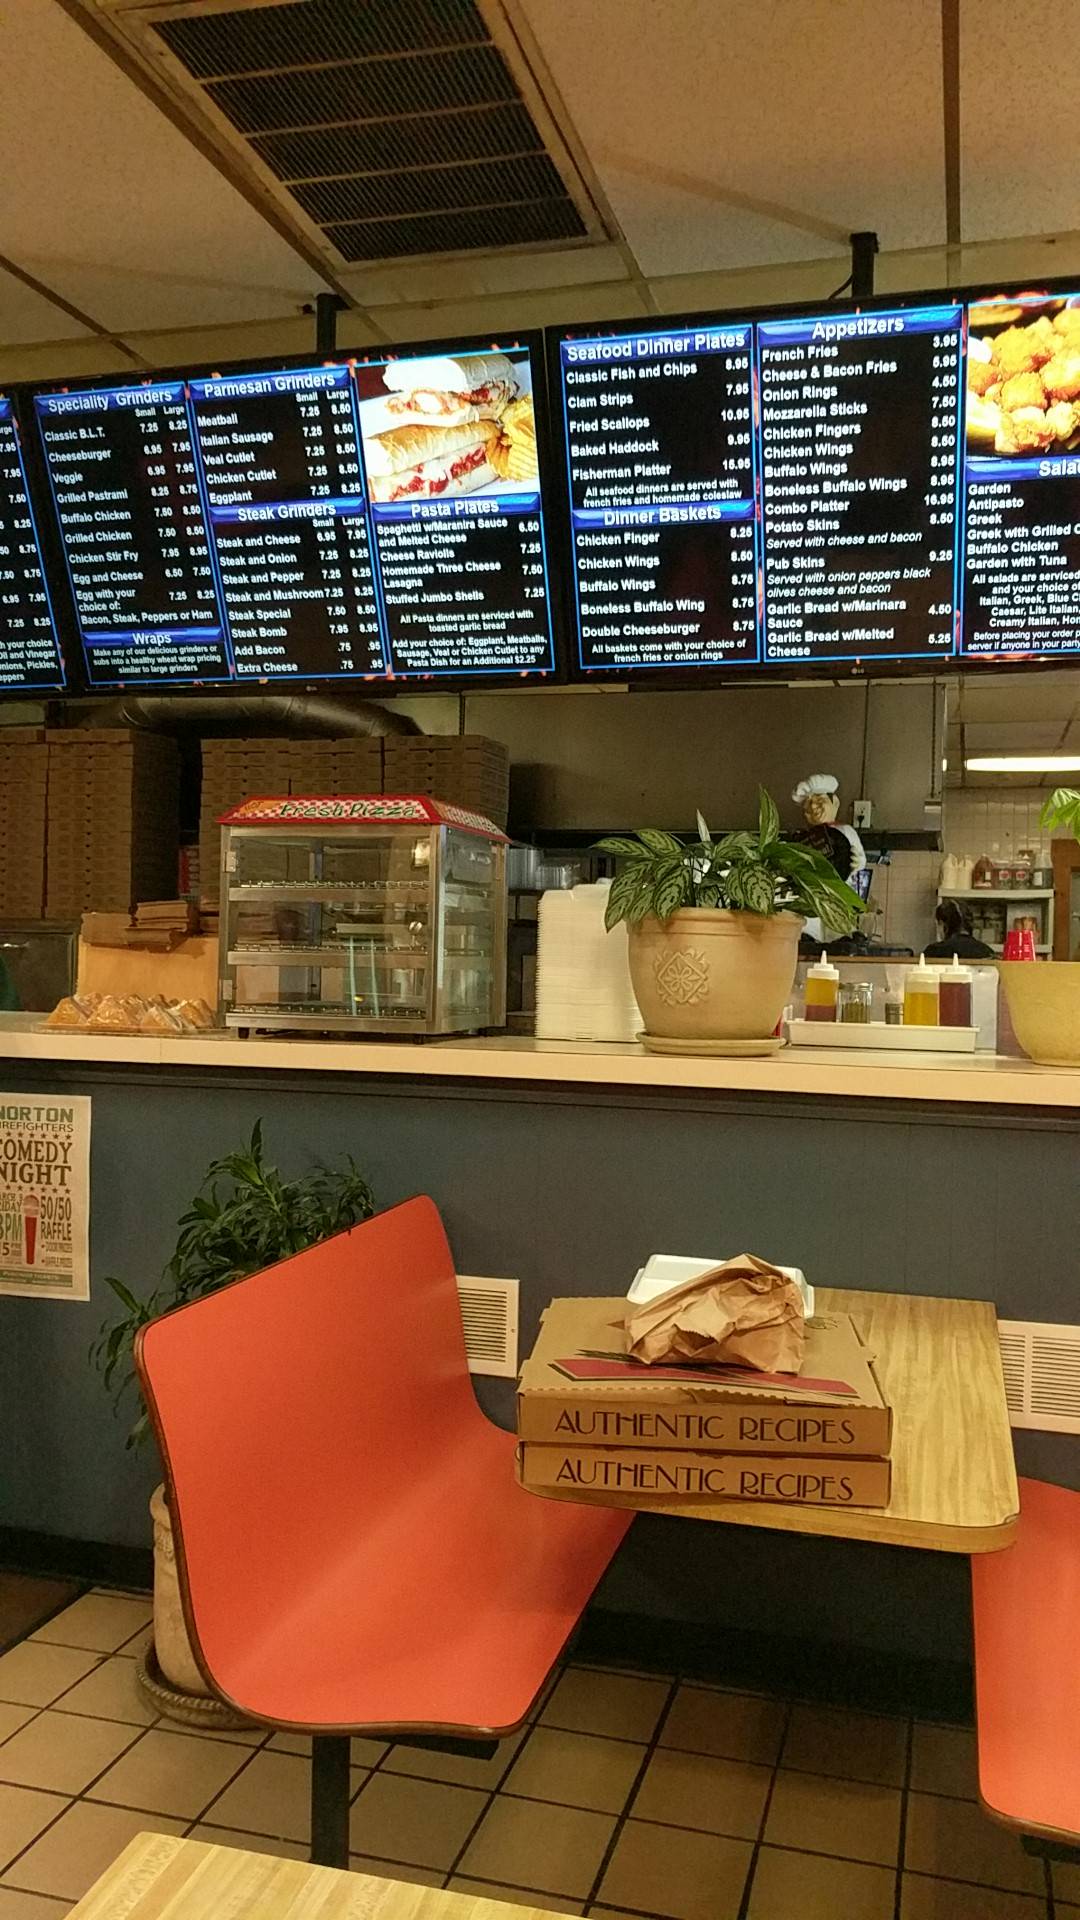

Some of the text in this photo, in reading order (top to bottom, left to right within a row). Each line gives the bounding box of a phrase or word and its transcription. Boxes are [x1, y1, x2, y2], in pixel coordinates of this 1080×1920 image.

[812, 317, 904, 340] Appetizers
[568, 333, 745, 361] Seafood Dinner Plates
[763, 346, 839, 362] French Fries
[567, 362, 697, 384] Classic Fish and Chips
[763, 361, 897, 382] Cheese & Bacon Fries
[205, 374, 335, 397] Parmesan Grinders
[296, 391, 349, 402] Small Large
[568, 393, 633, 408] Clam Strips
[763, 386, 837, 401] Onion Rings
[49, 390, 172, 414] Speciality Grinders
[135, 406, 184, 417] Small Large
[763, 403, 867, 421] Mozzarella Sticks
[198, 413, 237, 427] Meatball
[570, 417, 650, 433] Fried Scallops
[45, 430, 77, 441] Classic
[764, 423, 861, 440] Chicken Fingers
[201, 432, 273, 446] Italian Sausage
[49, 449, 111, 462] Cheeseburger
[571, 440, 659, 457] Baked Haddock
[204, 452, 255, 466] Veal Cutlet
[573, 464, 672, 480] Fisherman Platter
[765, 462, 847, 478] Buffalo Wings
[53, 472, 83, 484] Veggie
[586, 479, 738, 497] All seafood dinners are served with
[968, 483, 1011, 495] Garden
[57, 489, 128, 504] Grilled Pastrami
[209, 491, 252, 505] Eggplant
[412, 500, 499, 517] Pasta Plates
[765, 500, 849, 515] Combo Platter
[968, 498, 1024, 511] Antipasto
[61, 511, 131, 523] Buffalo Chicken
[238, 504, 336, 521] Steak Grinders
[604, 505, 721, 525] Dinner Baskets
[968, 513, 1002, 525] Greek
[313, 517, 364, 528] Small Large
[765, 520, 840, 534] Potato Skins
[577, 532, 660, 546] Chicken Finger
[967, 524, 1070, 540] Greek with Grilled
[217, 535, 300, 548] Steak and Cheese
[767, 531, 922, 548] Served with cheese and bacon
[380, 549, 455, 561] Cheese Raviolis
[967, 541, 1058, 555] Buffalo Chicken
[69, 552, 138, 564] Chicken Stir Fry
[578, 556, 660, 570] Chicken Wings
[767, 556, 825, 570] Pub Skins
[967, 555, 1067, 569] Garden with Tuna
[382, 562, 501, 576] Homemade Three Cheese
[354, 585, 373, 595] 8.25
[383, 579, 423, 589] Lasagna
[225, 589, 324, 602] Steak and Mushroom
[325, 587, 343, 597] 7.25
[524, 588, 544, 598] 7.25
[581, 600, 704, 615] Boneless Buffalo Wing
[768, 598, 906, 615] Garlic Bread w/Marinara
[229, 609, 291, 621] Steak Special
[582, 623, 700, 637] Double Cheeseburger
[768, 617, 803, 629] Sauce
[232, 626, 287, 638] Steak Bomb
[133, 633, 172, 646] Wraps
[235, 645, 285, 656] Add Bacon
[237, 662, 298, 673] Extra Cheese
[280, 802, 414, 817] Fresh Pizza
[0, 1138, 72, 1164] OMEDY
[40, 1195, 72, 1221] 50/50
[41, 1221, 72, 1240] RAFFLE
[554, 1408, 855, 1444] AUTHENTIC RECIPES
[557, 1458, 853, 1500] AUTHENTIC RECIPES
